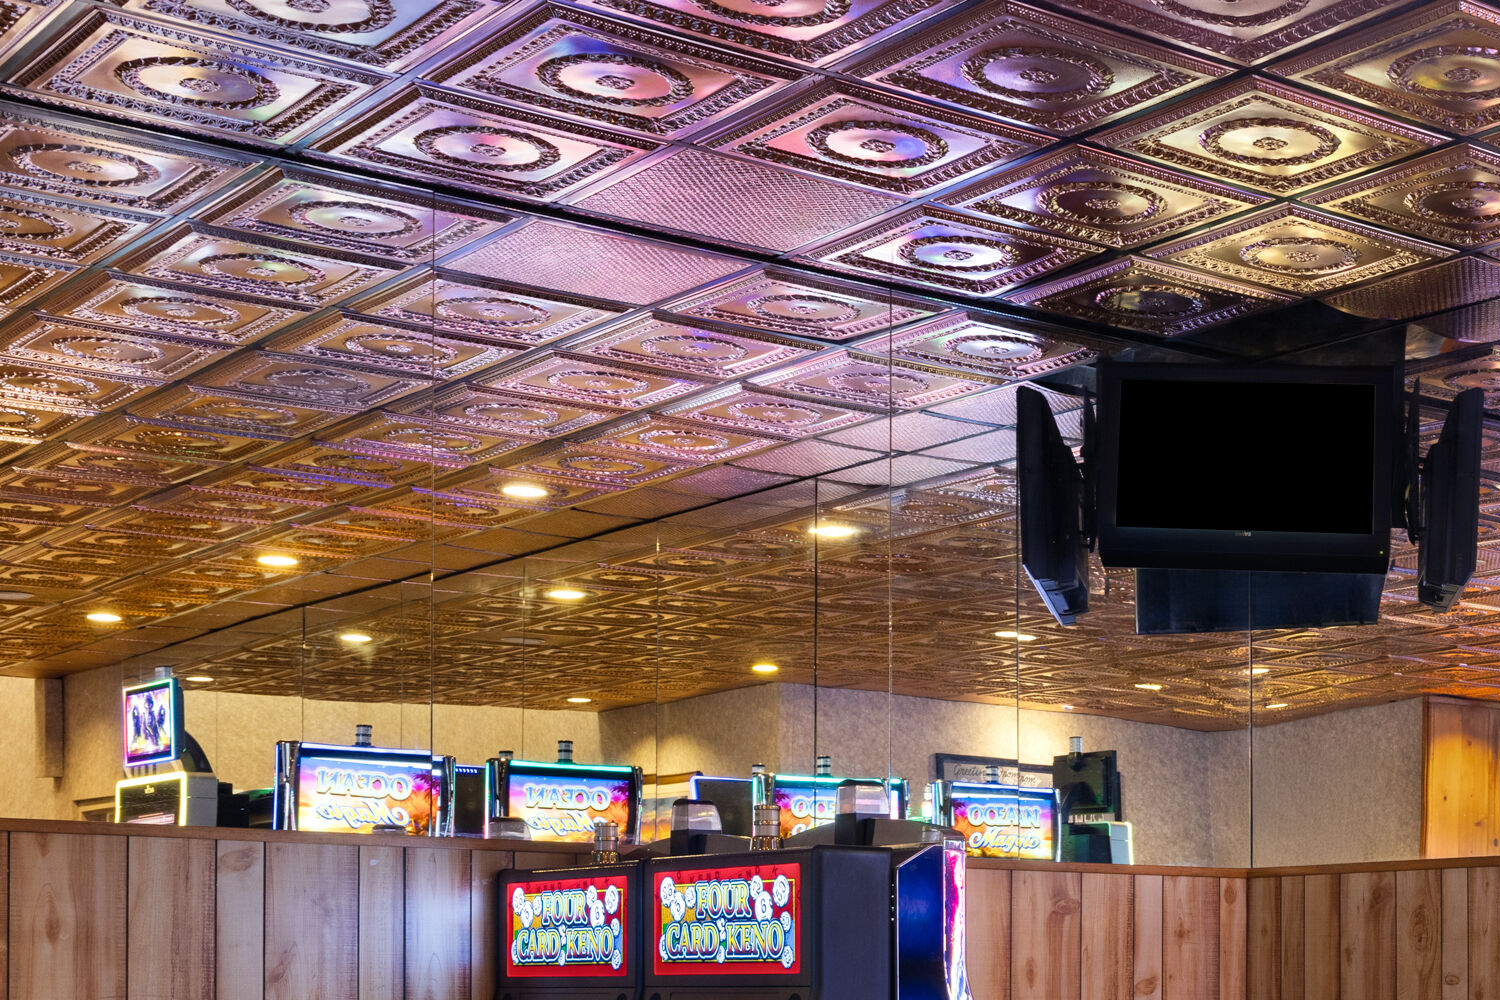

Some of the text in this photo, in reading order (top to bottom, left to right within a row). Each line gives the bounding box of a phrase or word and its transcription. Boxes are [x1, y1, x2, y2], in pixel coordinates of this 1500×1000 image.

[791, 795, 836, 819] OCE
[542, 889, 588, 926] FOUR
[696, 880, 752, 920] FOUR
[517, 925, 614, 962] CARD KENO
[666, 919, 784, 959] CARD KENO
